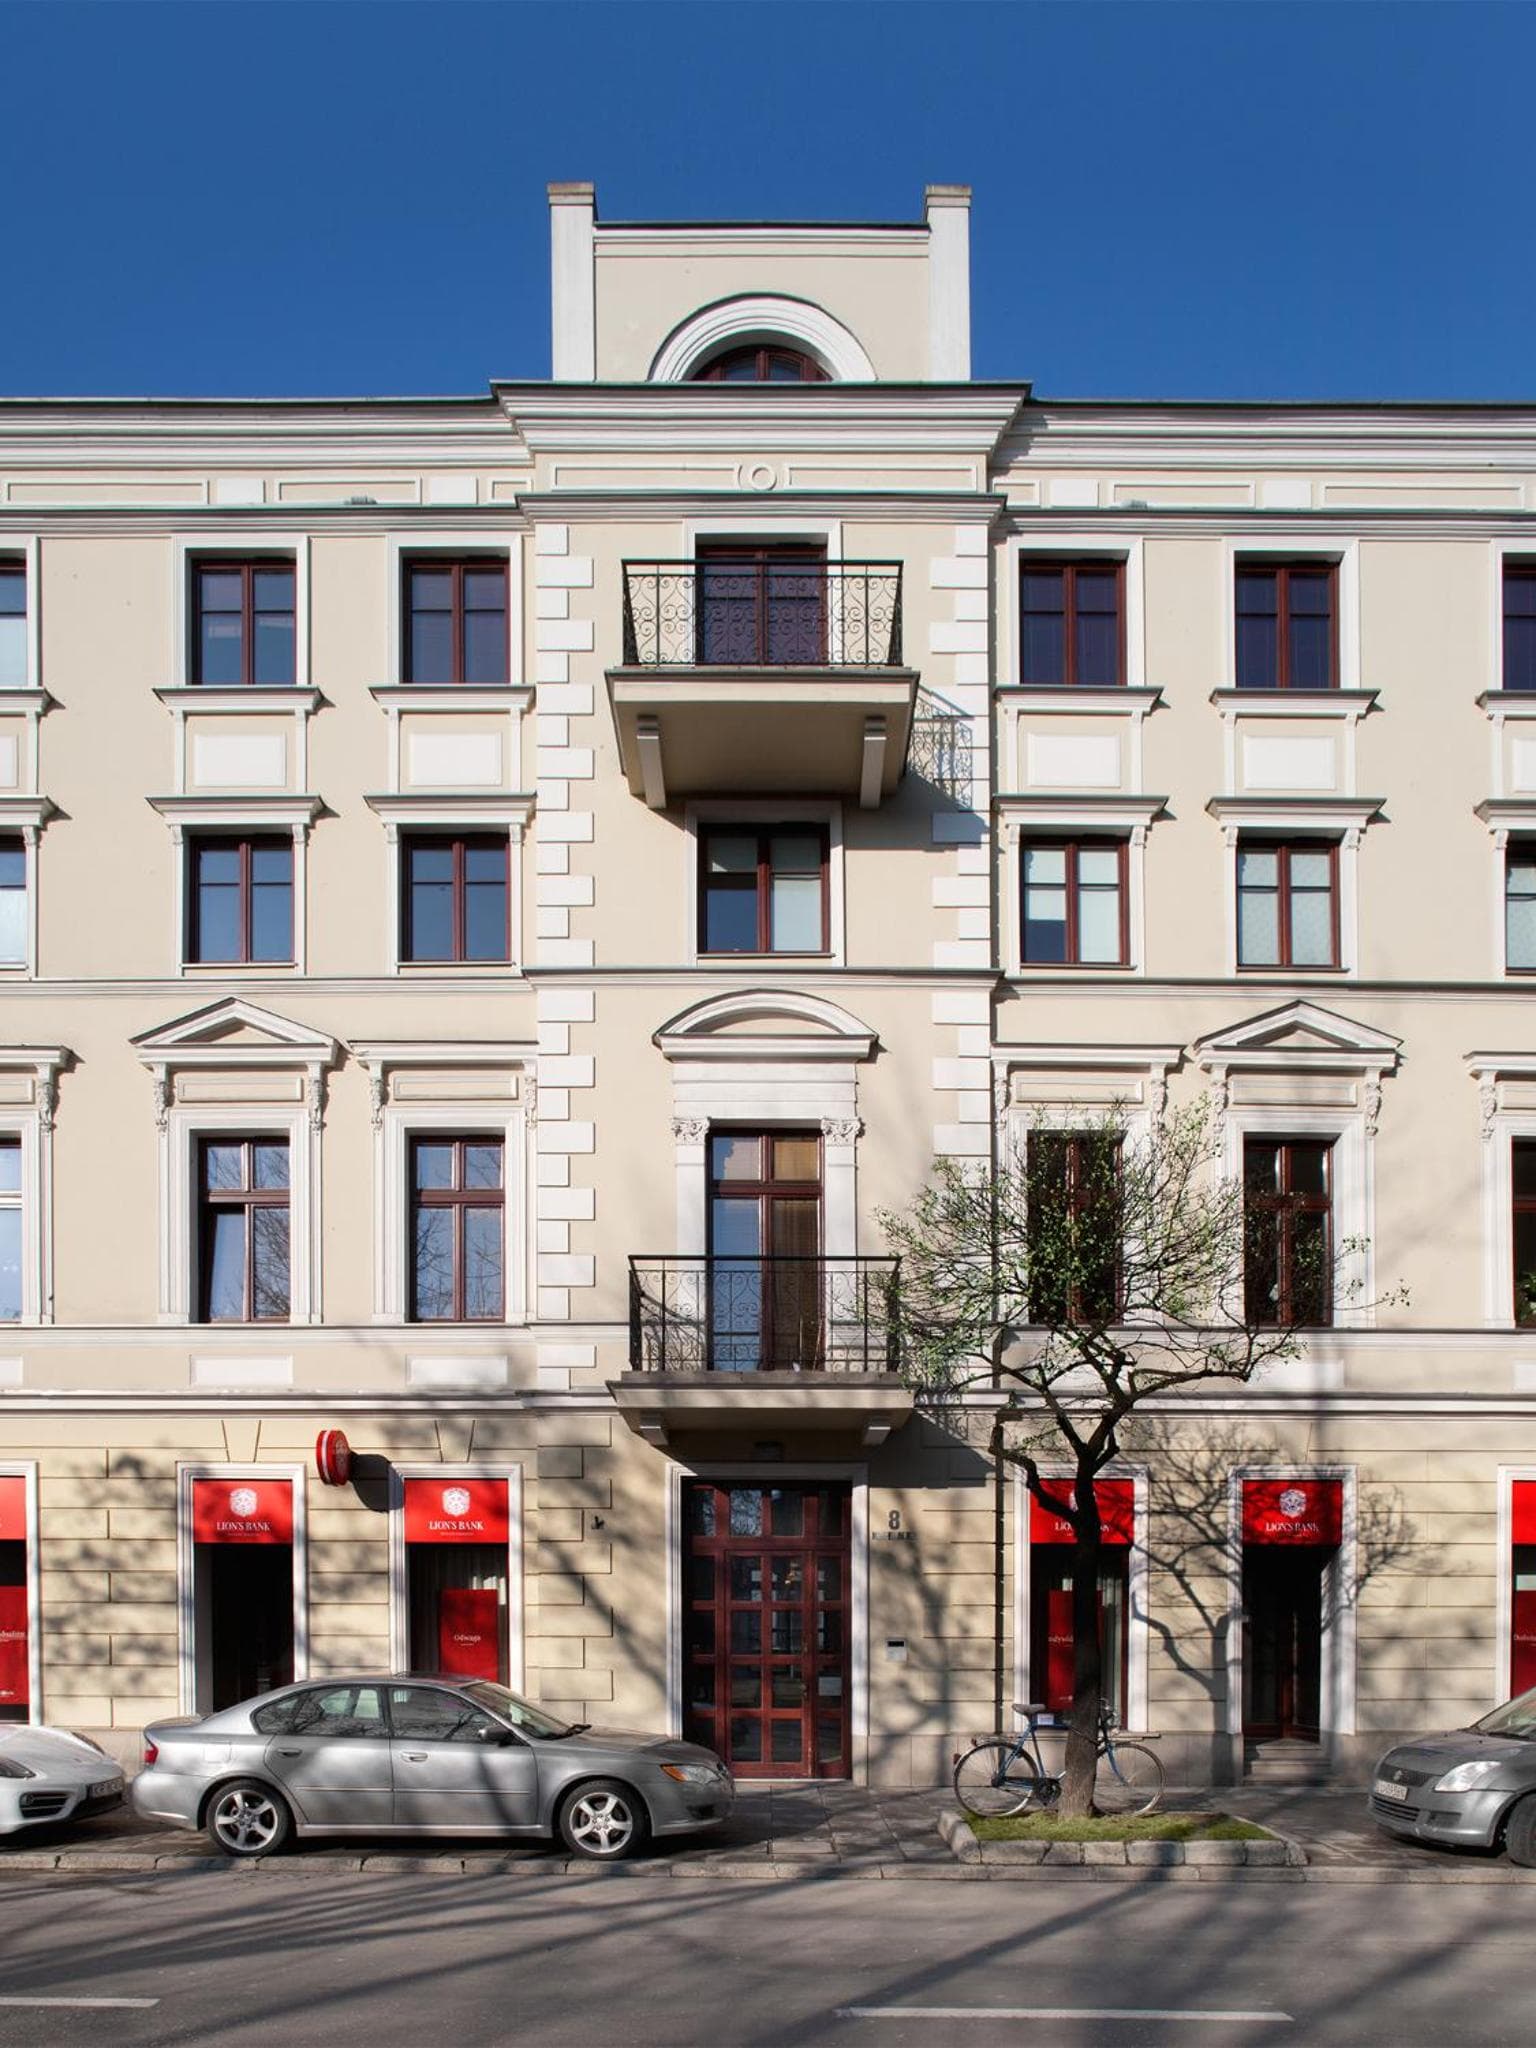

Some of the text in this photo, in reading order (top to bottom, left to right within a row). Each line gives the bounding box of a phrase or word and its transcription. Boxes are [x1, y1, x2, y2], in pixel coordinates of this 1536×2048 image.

[428, 1520, 484, 1530] LION'S BANK
[889, 1510, 900, 1530] 8
[216, 1521, 270, 1531] LION'S BANK
[1294, 1521, 1320, 1532] BANK
